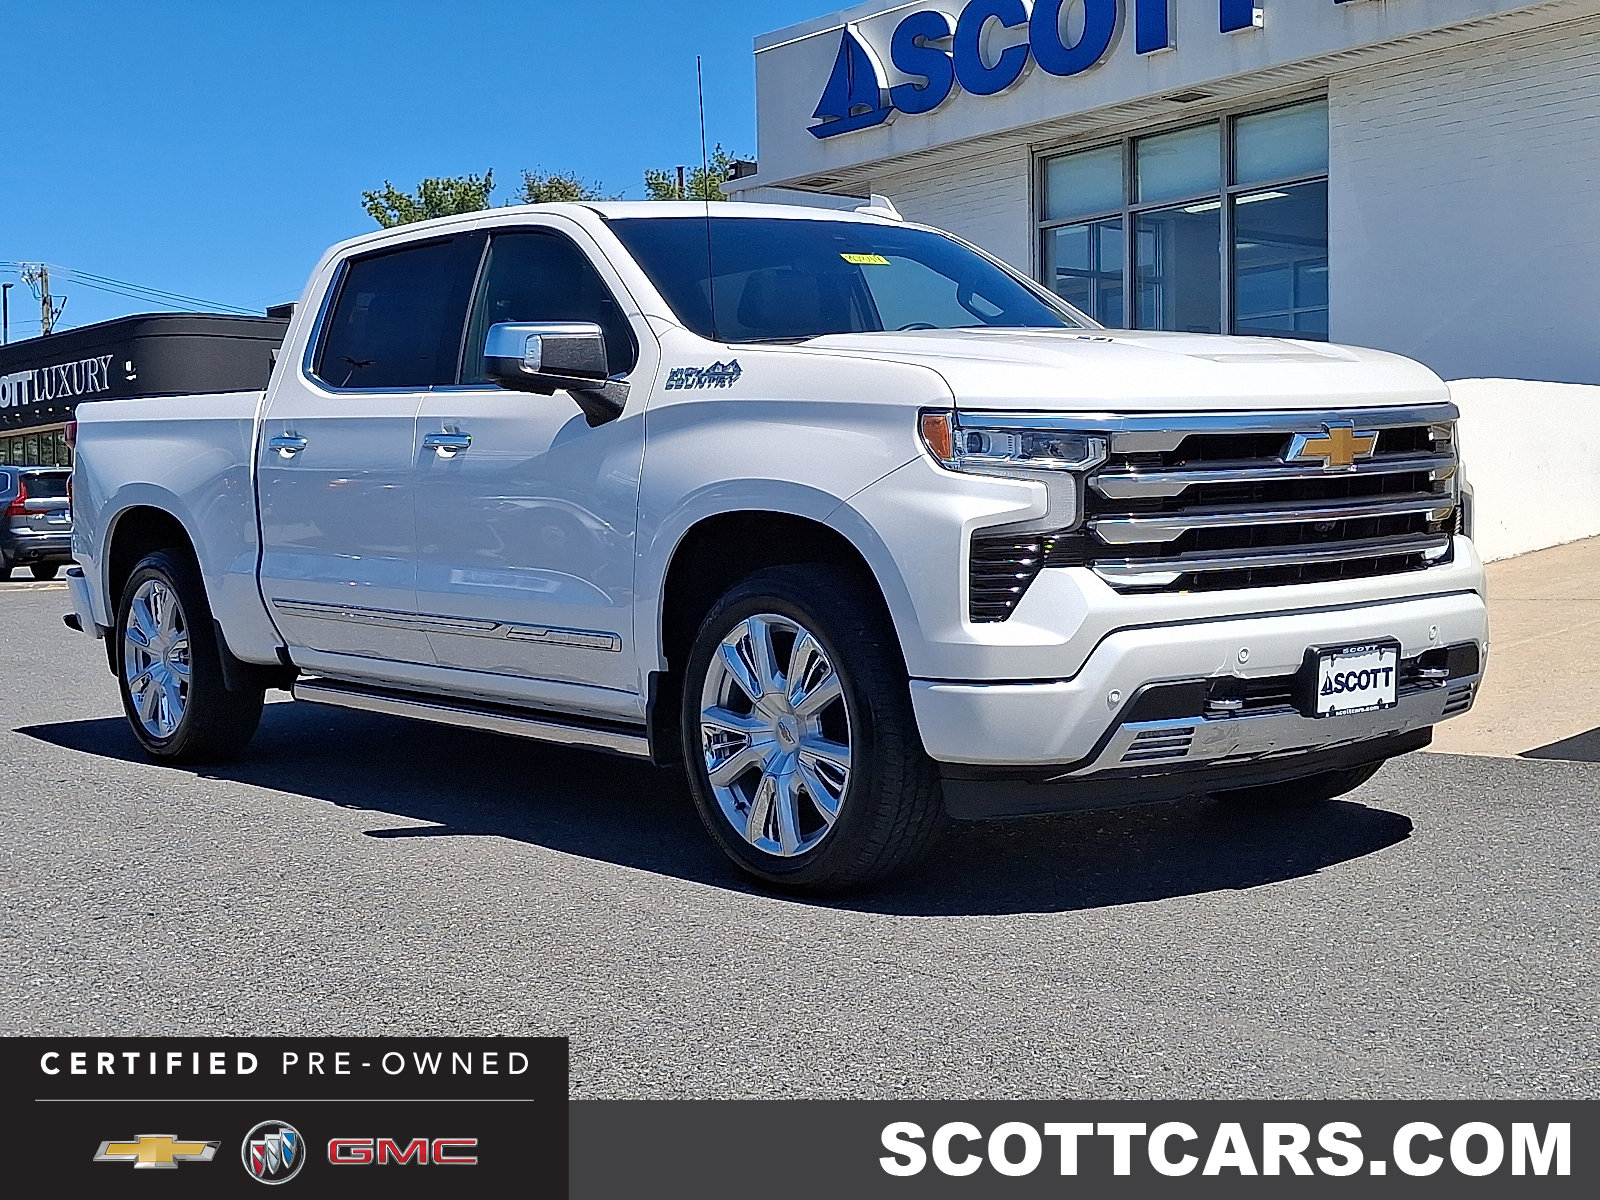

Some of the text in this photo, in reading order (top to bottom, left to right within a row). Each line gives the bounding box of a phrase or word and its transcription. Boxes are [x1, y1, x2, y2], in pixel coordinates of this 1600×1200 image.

[890, 0, 1255, 114] SCO
[32, 354, 114, 402] LUXURY
[1343, 645, 1378, 653] SCOTT
[1334, 667, 1393, 693] SCOTT
